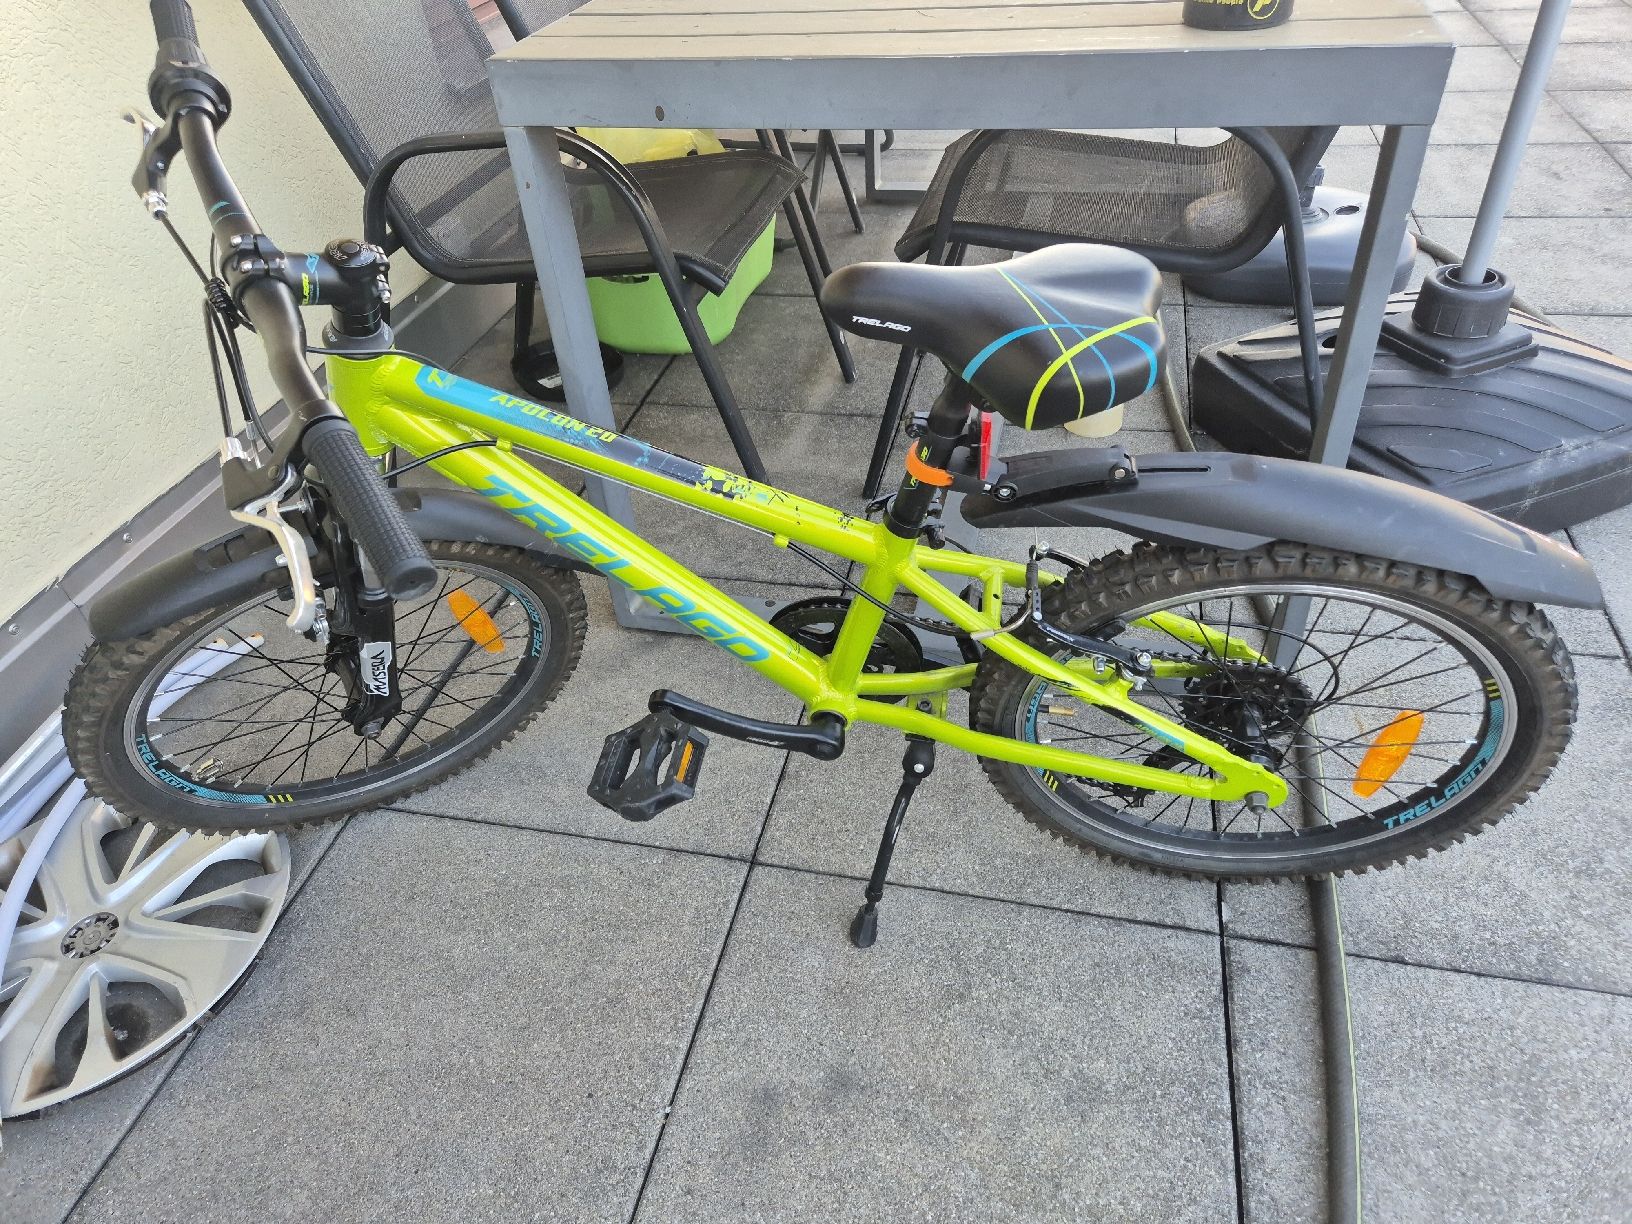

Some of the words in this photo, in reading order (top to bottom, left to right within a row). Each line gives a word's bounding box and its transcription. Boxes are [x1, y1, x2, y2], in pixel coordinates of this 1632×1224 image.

[852, 315, 912, 332] TRELAGO
[488, 394, 586, 431] APOLON
[585, 427, 620, 443] 20
[481, 474, 771, 663] TRELAGO
